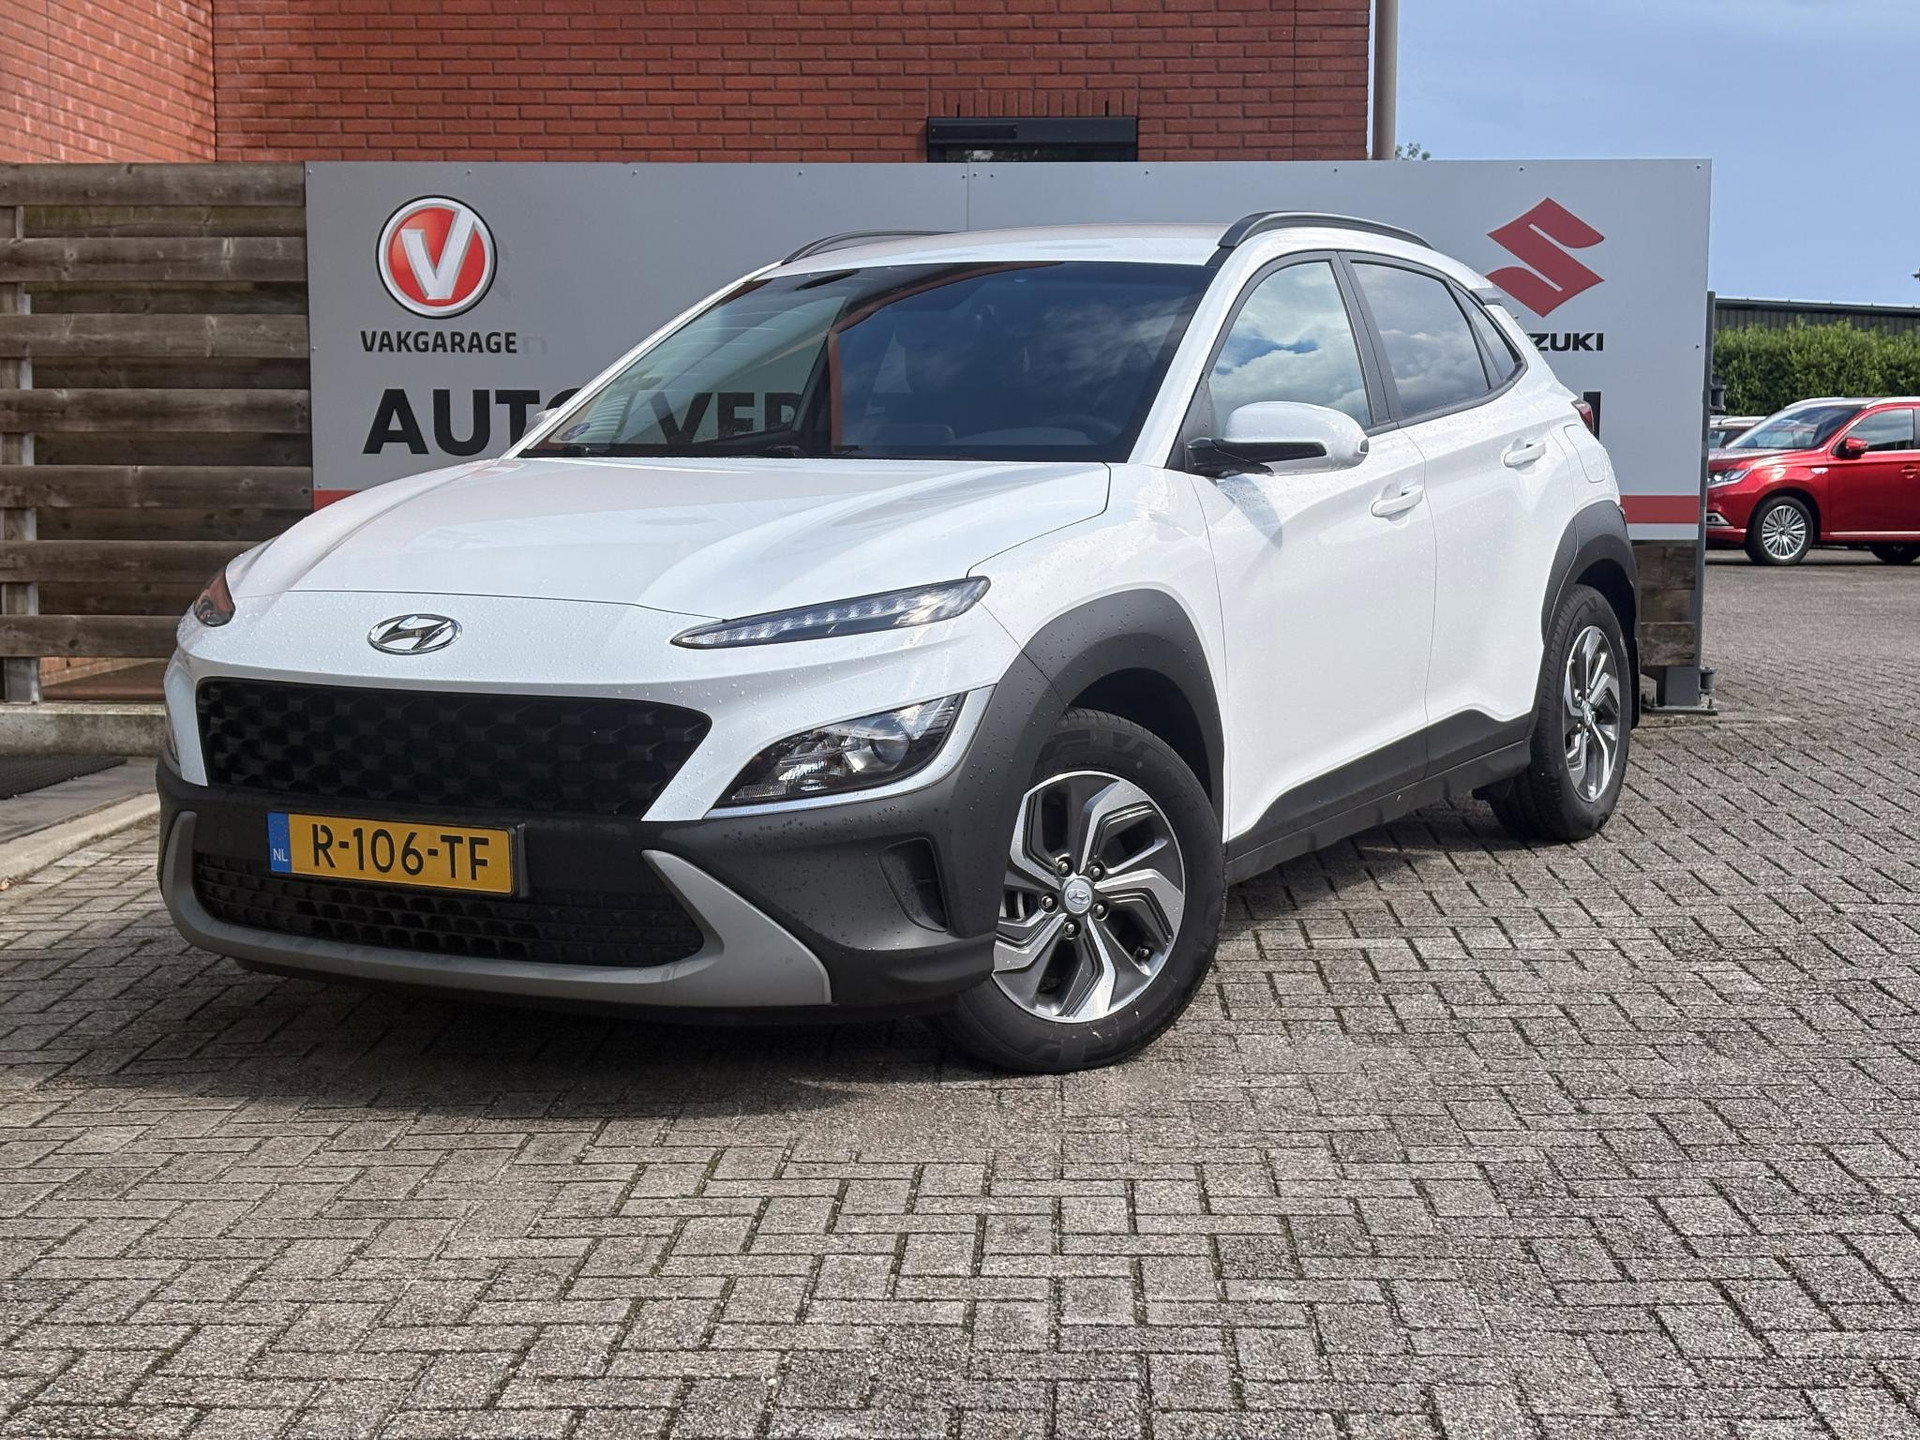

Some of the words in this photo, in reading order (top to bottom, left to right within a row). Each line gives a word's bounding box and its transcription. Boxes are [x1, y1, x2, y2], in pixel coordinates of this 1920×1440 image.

[360, 330, 518, 354] VAKGARAGE
[1527, 332, 1604, 352] ZUKI
[273, 848, 289, 862] NL
[311, 823, 490, 881] R-106-TF
